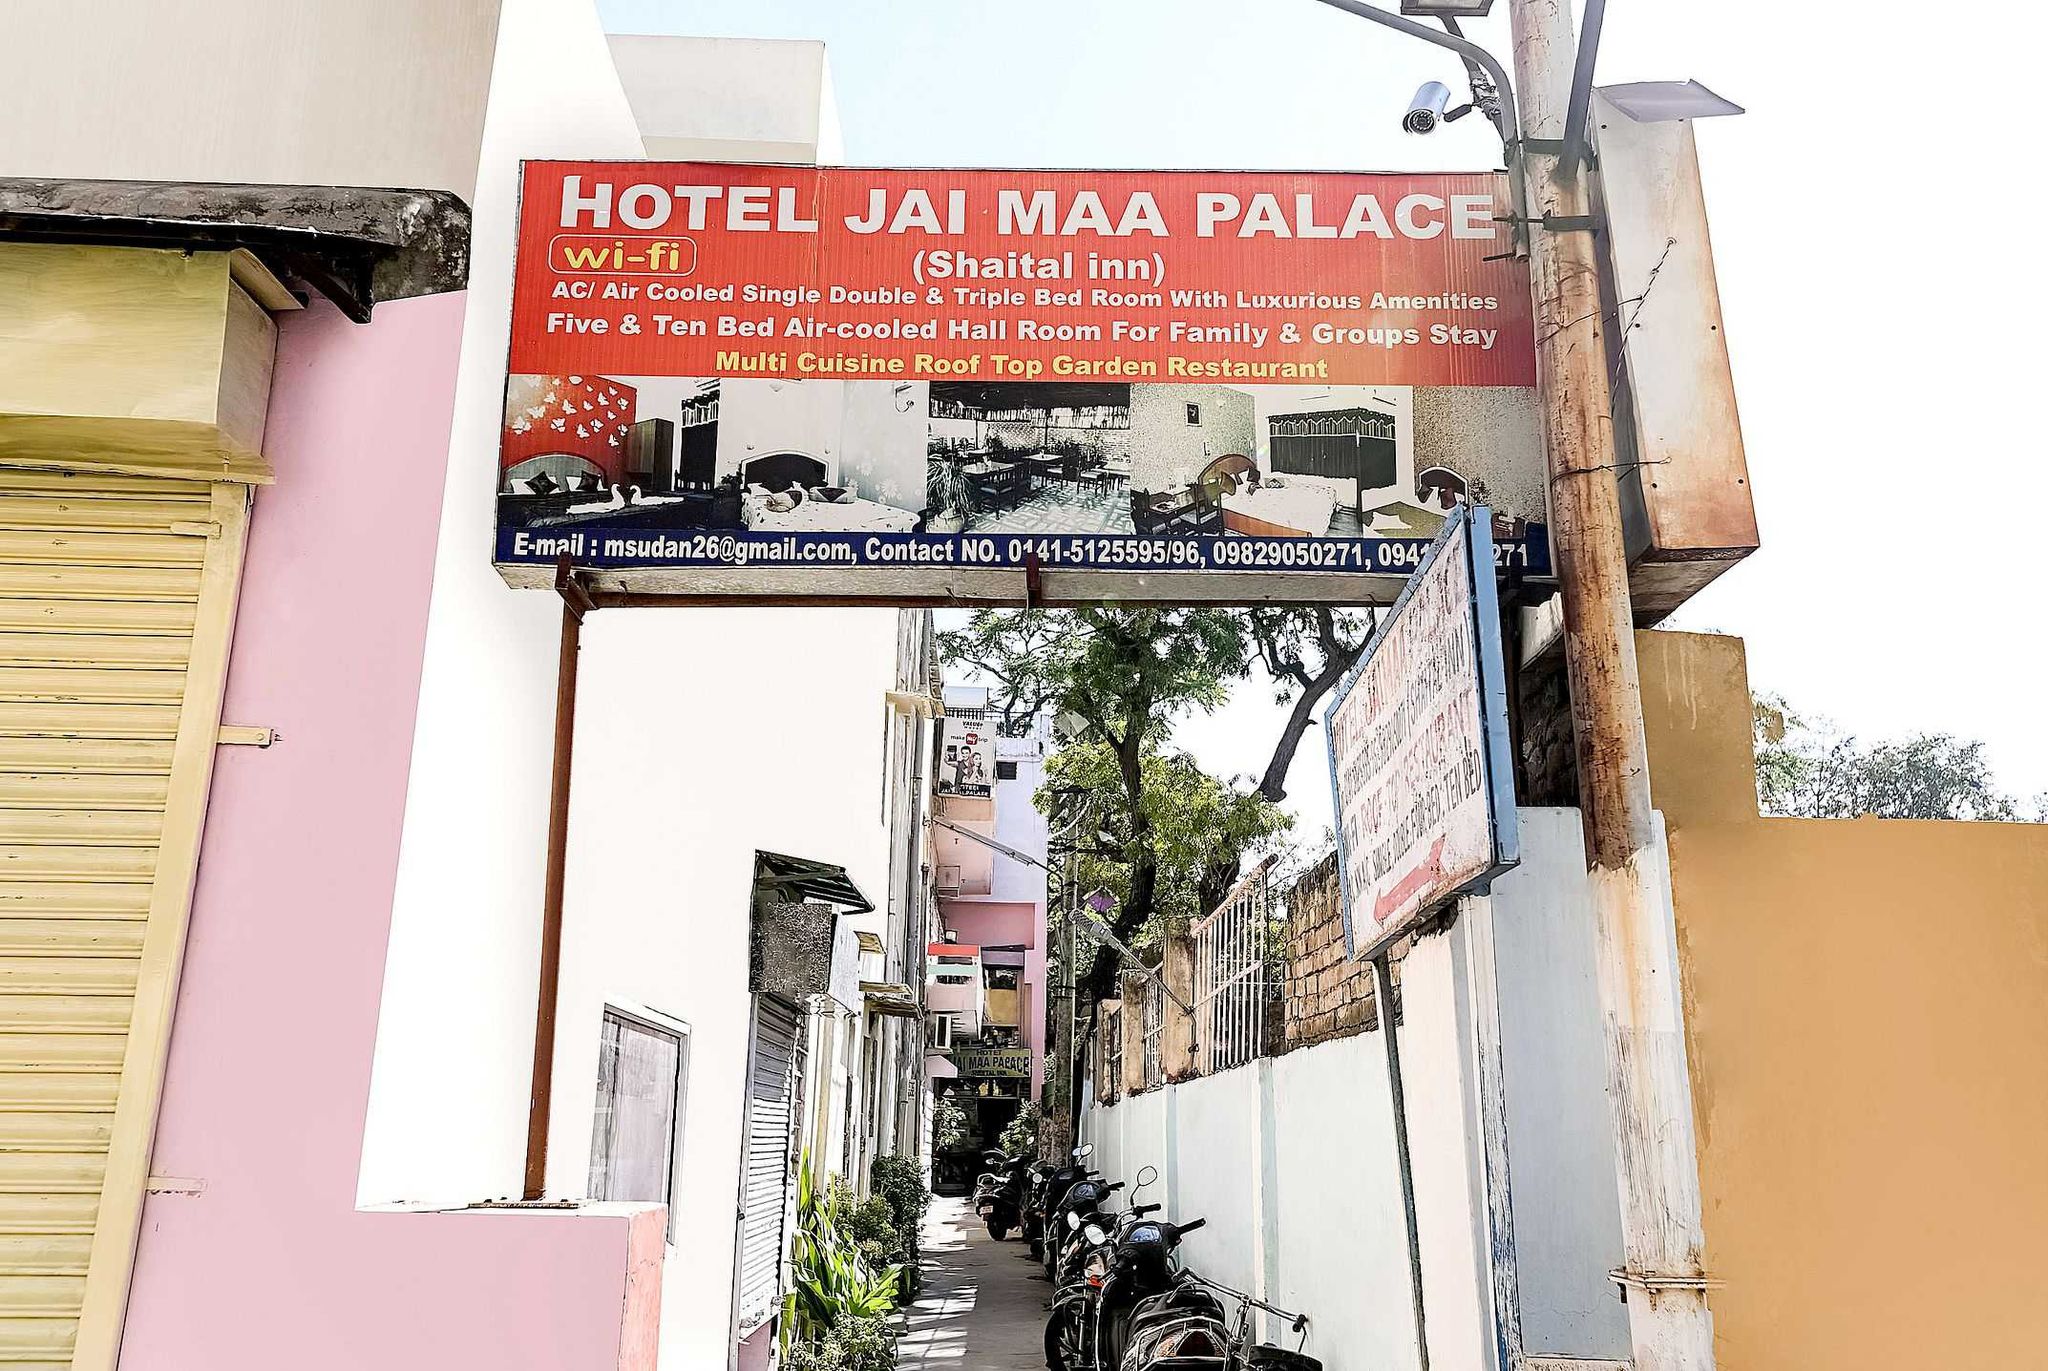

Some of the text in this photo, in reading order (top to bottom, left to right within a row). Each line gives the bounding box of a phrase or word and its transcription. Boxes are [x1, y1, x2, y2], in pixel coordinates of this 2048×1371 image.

[560, 175, 1497, 240] HOTEL JAI MAA PALACE
[562, 241, 681, 271] wi-fi
[913, 249, 1165, 288] (Shaital inn)
[551, 281, 1498, 311] AC/ Air Cooled Single Double & Triple Bed Room With Luxurious Amenities
[547, 312, 1498, 350] Five & Ten Bed Air-cooled Hall Room For Family & Groups Stay
[716, 351, 1329, 380] Multi Cuisine Roof Top Garden Restaurant
[513, 532, 584, 557] E-mail
[603, 535, 857, 565] msudan26@gmail.com,
[865, 537, 954, 562] Contact
[961, 538, 1001, 563] NO.
[1008, 538, 1206, 568] 0141-5125595/96,
[1213, 540, 1372, 570] 09829050271,
[1443, 759, 1462, 814] TEN
[1462, 743, 1482, 800] BED
